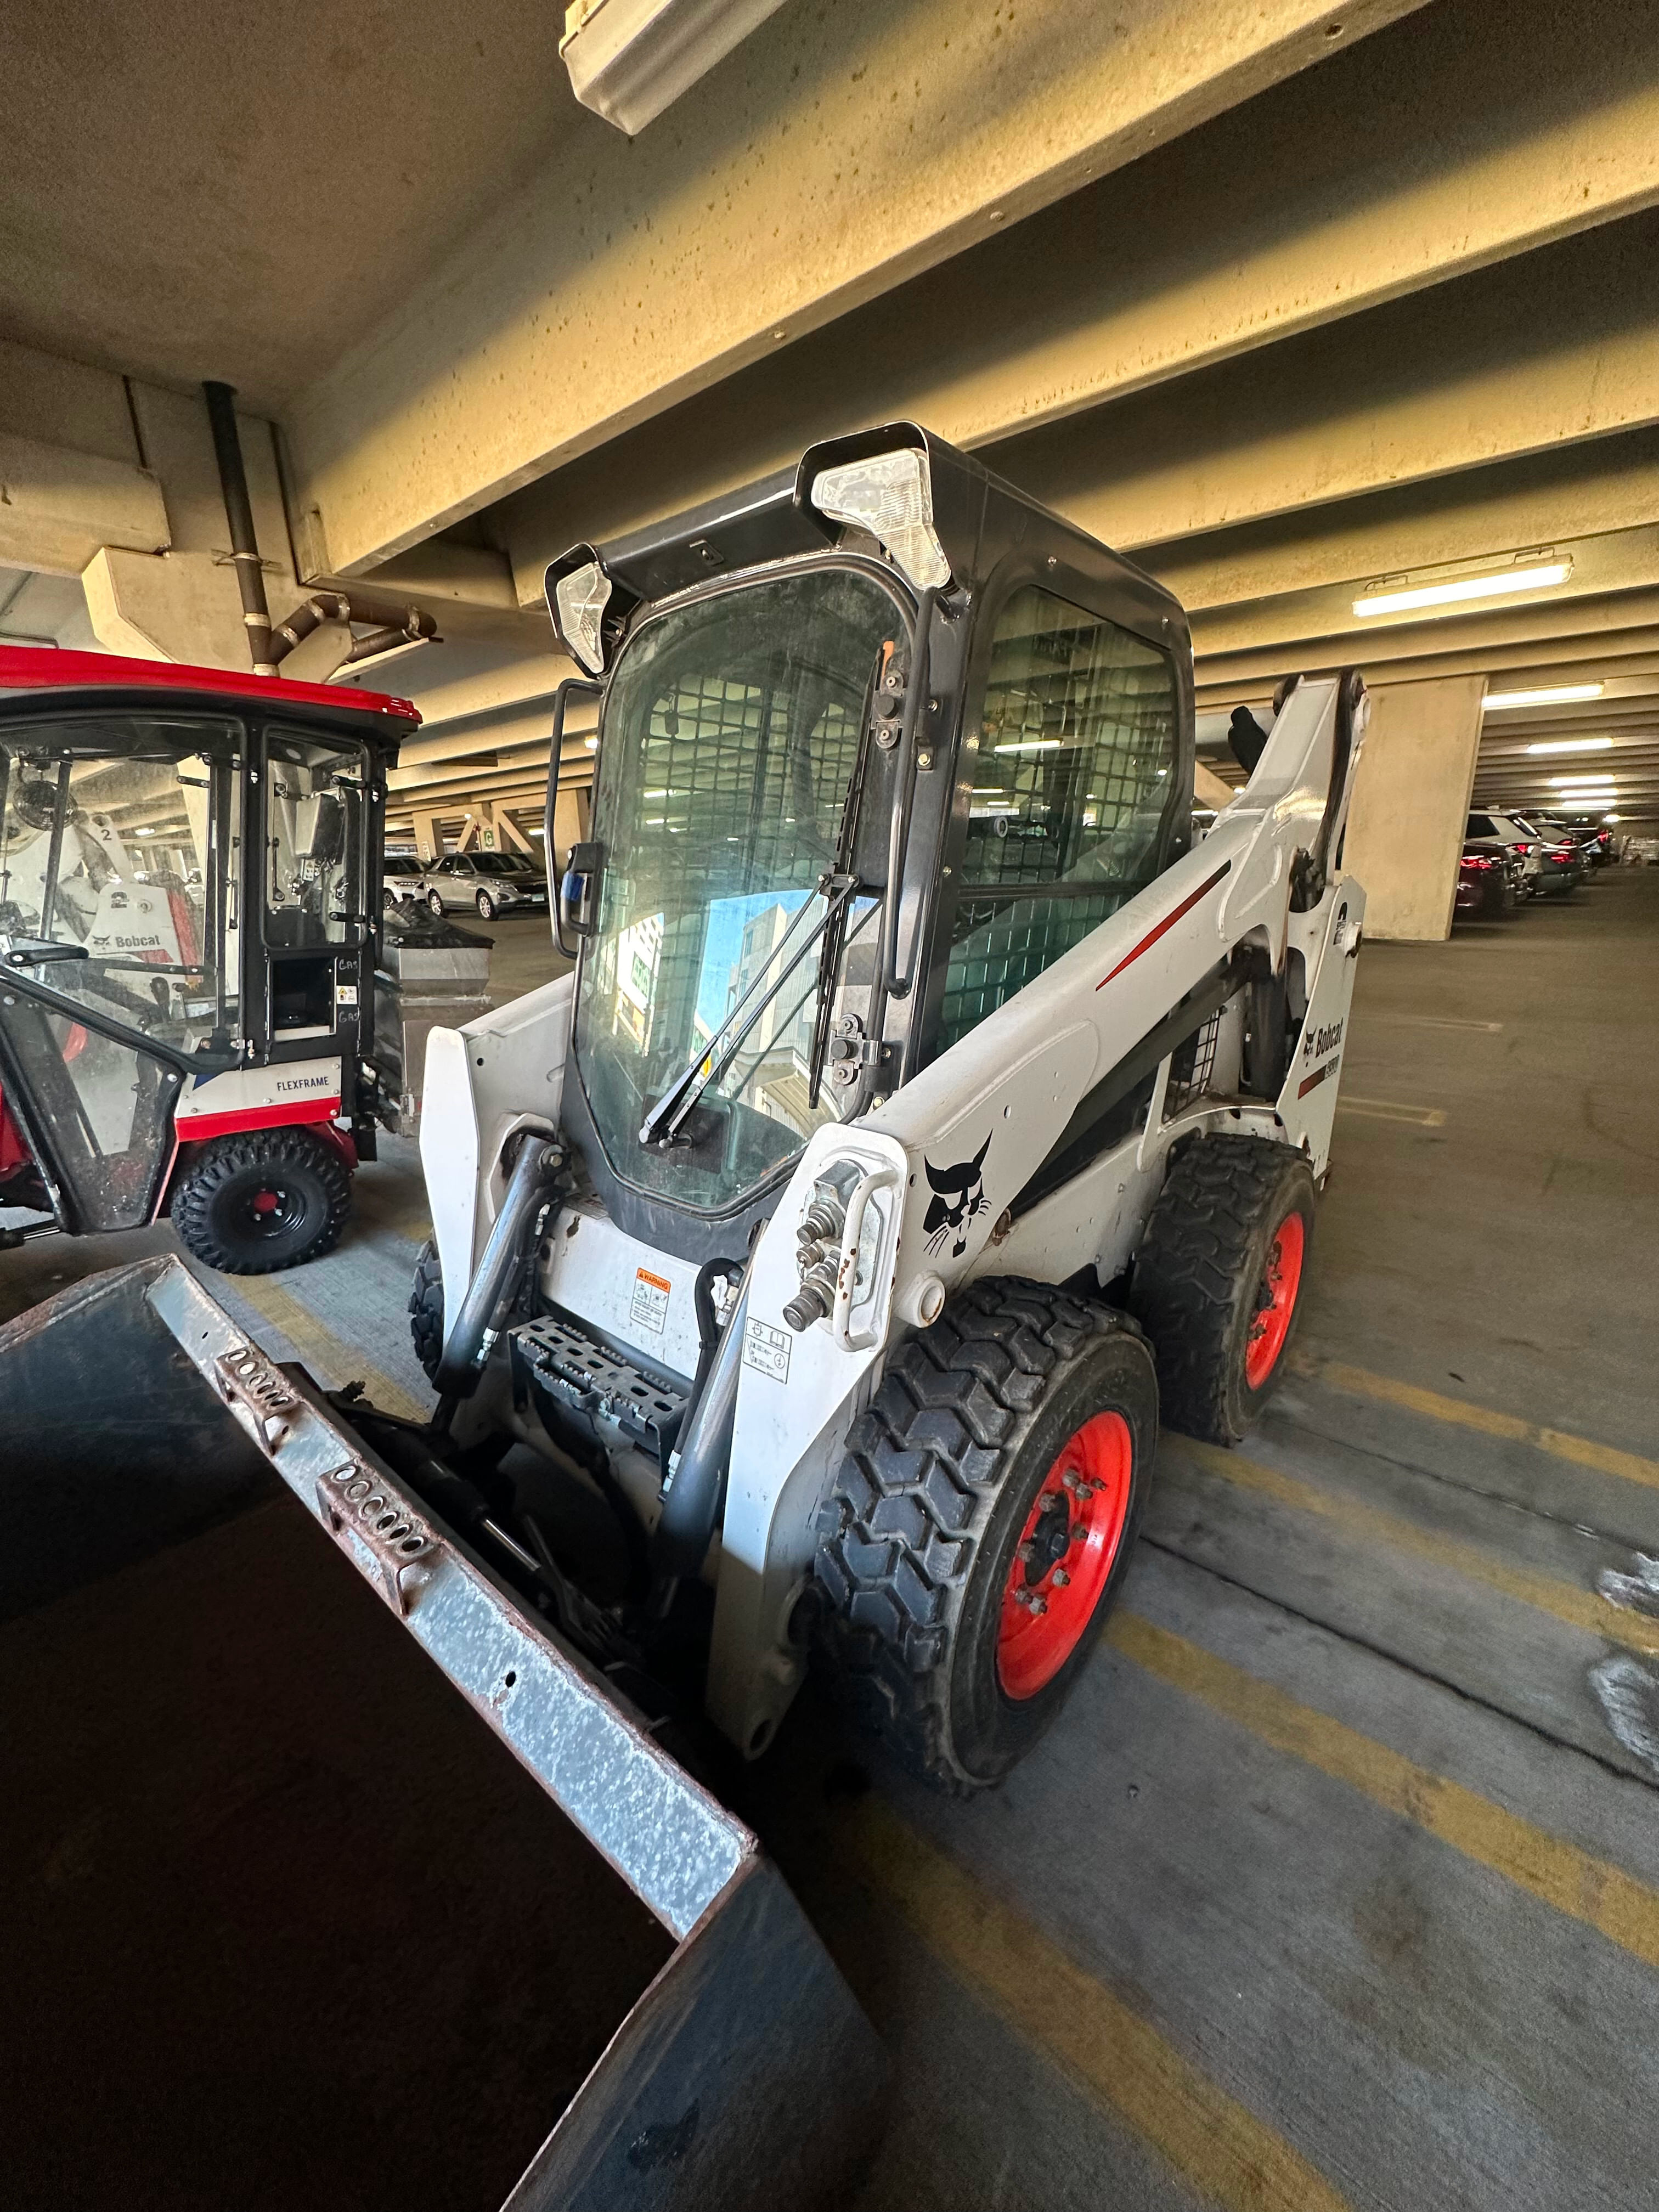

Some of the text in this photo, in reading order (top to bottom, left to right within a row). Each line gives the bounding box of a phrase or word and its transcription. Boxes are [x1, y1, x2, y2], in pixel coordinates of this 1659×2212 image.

[101, 830, 112, 840] 2
[486, 832, 492, 845] G
[111, 891, 129, 909] 2
[115, 934, 160, 947] Bobcat
[1316, 1017, 1343, 1058] Bobcat
[277, 1076, 329, 1091] FLEXFRAME
[644, 1273, 668, 1289] WARNING
